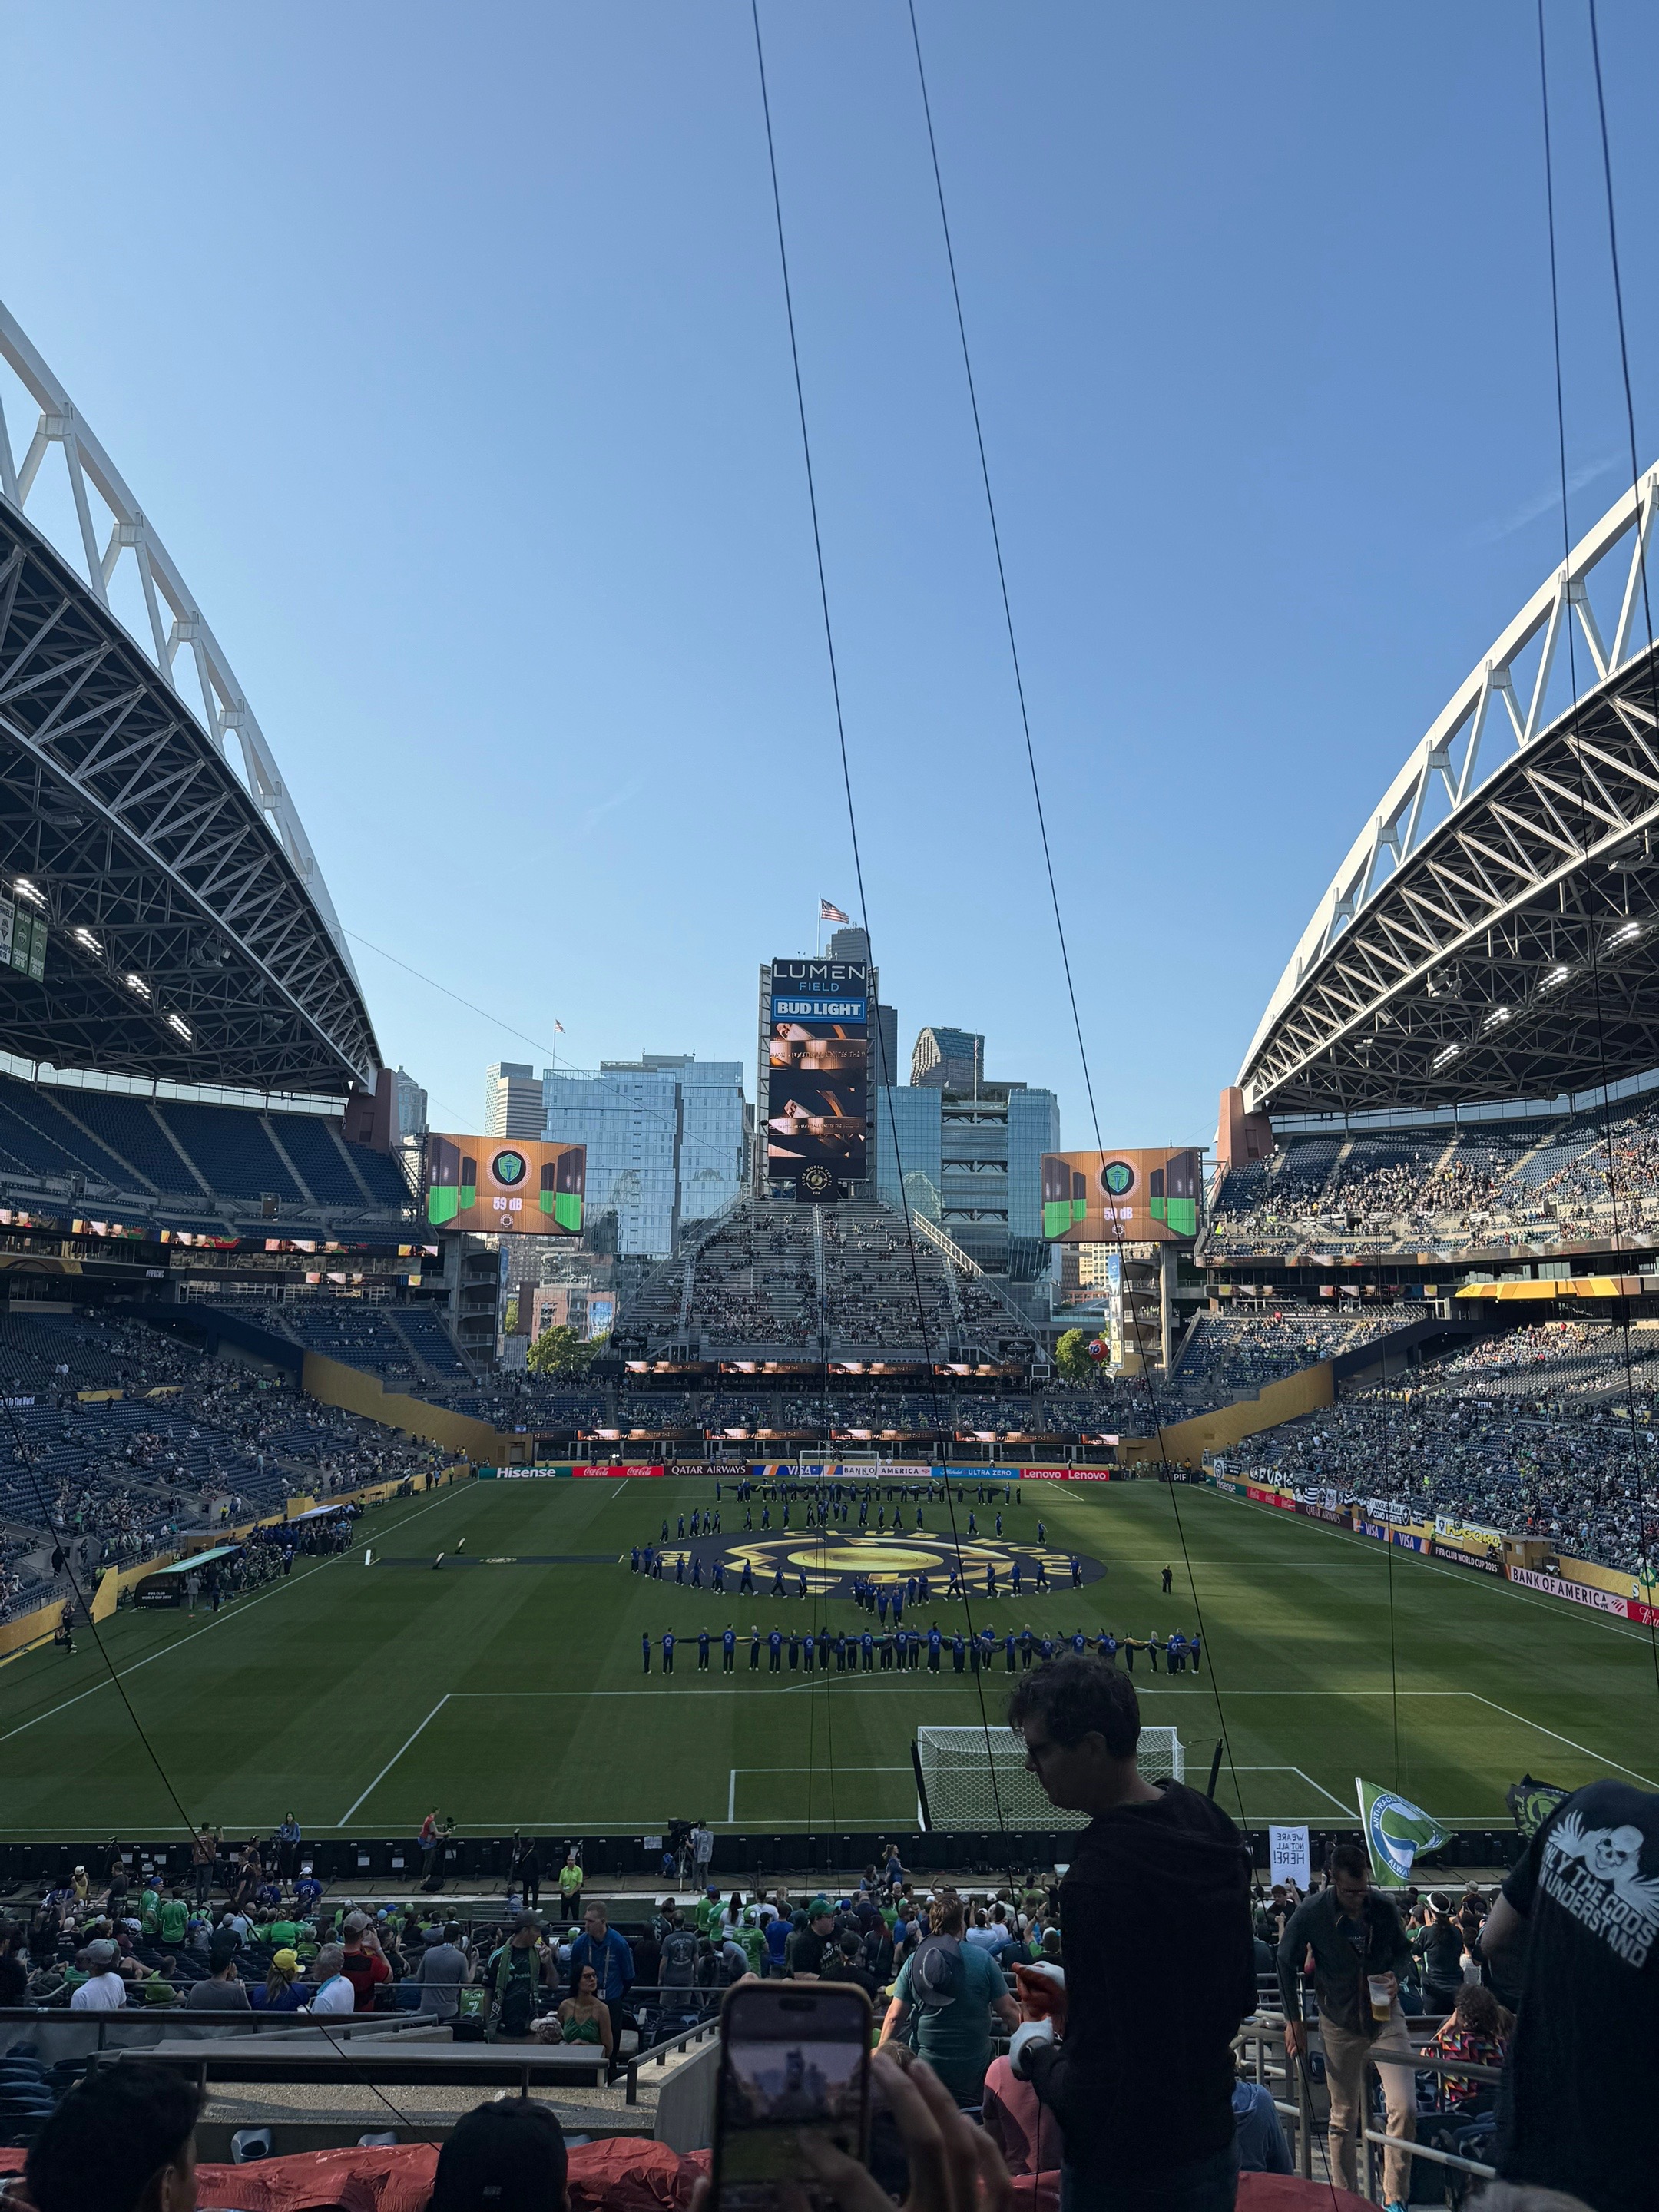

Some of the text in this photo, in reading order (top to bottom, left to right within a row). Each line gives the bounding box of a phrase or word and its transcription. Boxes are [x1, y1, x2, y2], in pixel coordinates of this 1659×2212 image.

[773, 963, 866, 980] LUMEN
[799, 982, 839, 992] FIELD
[777, 1002, 860, 1015] BUD LIGHT
[492, 1197, 523, 1211] 59 dB
[1104, 1207, 1133, 1220] 59 dB
[496, 1467, 556, 1479] Hisense
[671, 1465, 746, 1475] QATAR AIRWAYS
[786, 1465, 811, 1475] VISA
[1024, 1469, 1061, 1479] Lenovo
[1068, 1469, 1106, 1479] Lenovo
[1216, 1478, 1236, 1493] Hisense
[1364, 1522, 1379, 1538] VISA
[1398, 1532, 1415, 1550] VISA
[1435, 1546, 1445, 1558] FIFA
[1445, 1549, 1458, 1561] CLUB
[1458, 1553, 1475, 1565] WORLD
[1475, 1558, 1485, 1568] CUP
[1513, 1568, 1540, 1588] BANK
[1542, 1577, 1555, 1592] OF
[1569, 1864, 1607, 1906] THE
[1601, 1891, 1657, 1948] GODS
[1545, 1876, 1649, 1969] UNDERSTAND
[741, 1938, 752, 1952] 5
[469, 2001, 479, 2012] 7
